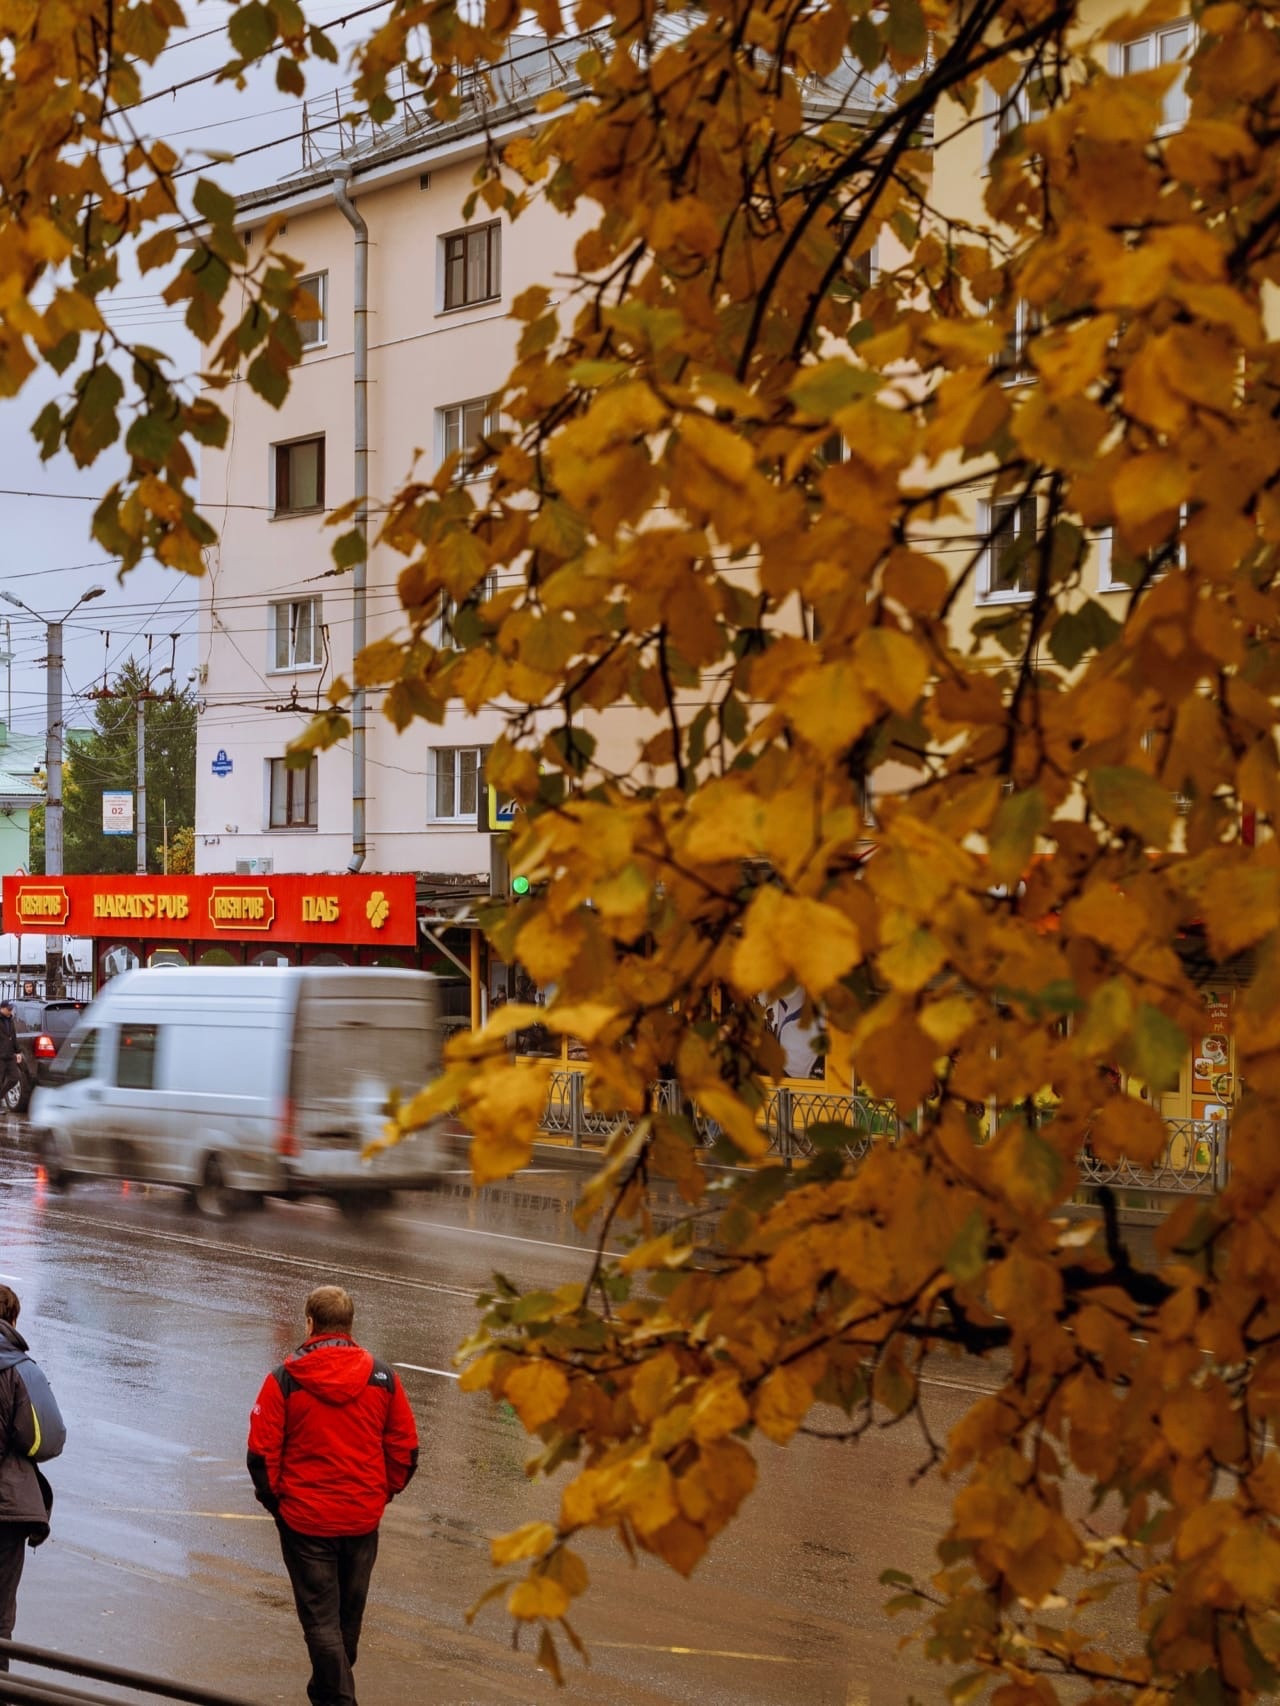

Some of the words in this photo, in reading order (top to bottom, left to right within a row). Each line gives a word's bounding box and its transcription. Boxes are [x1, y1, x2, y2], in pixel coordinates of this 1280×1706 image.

[111, 807, 124, 815] 02
[21, 895, 43, 915] IRISH
[44, 895, 62, 915] PUB
[157, 895, 189, 918] PUB
[215, 897, 241, 918] IRISH
[242, 897, 264, 919] PUB
[302, 896, 340, 922] ПАБ
